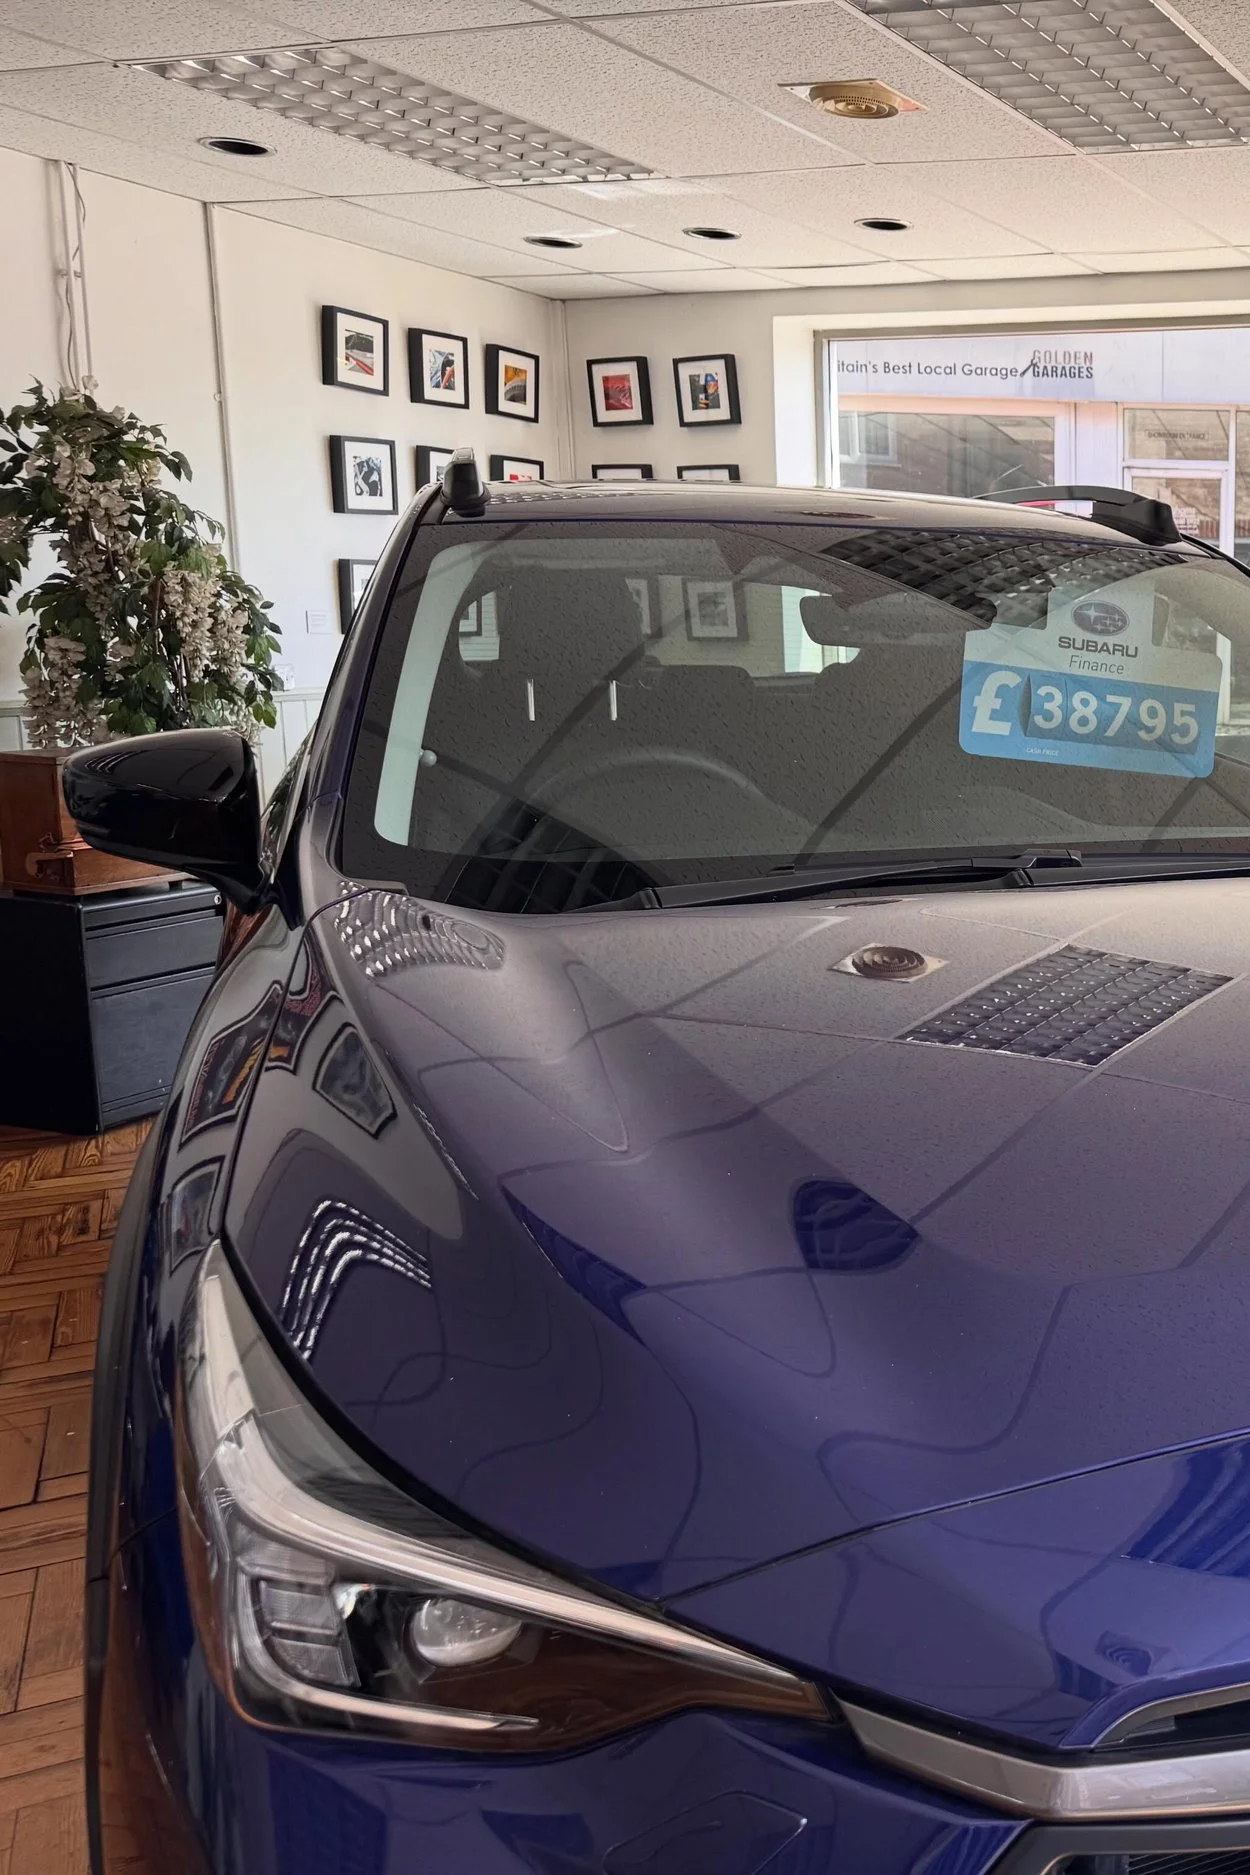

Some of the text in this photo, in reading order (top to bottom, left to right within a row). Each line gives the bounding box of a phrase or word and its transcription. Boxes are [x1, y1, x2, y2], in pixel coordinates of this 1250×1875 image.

[1033, 349, 1093, 365] GOLDEN
[883, 361, 912, 375] Best
[917, 362, 957, 376] Local
[961, 363, 1019, 380] Garage
[1032, 364, 1093, 379] GARAGES
[1058, 636, 1139, 659] SUBARU
[1068, 655, 1125, 675] Finance
